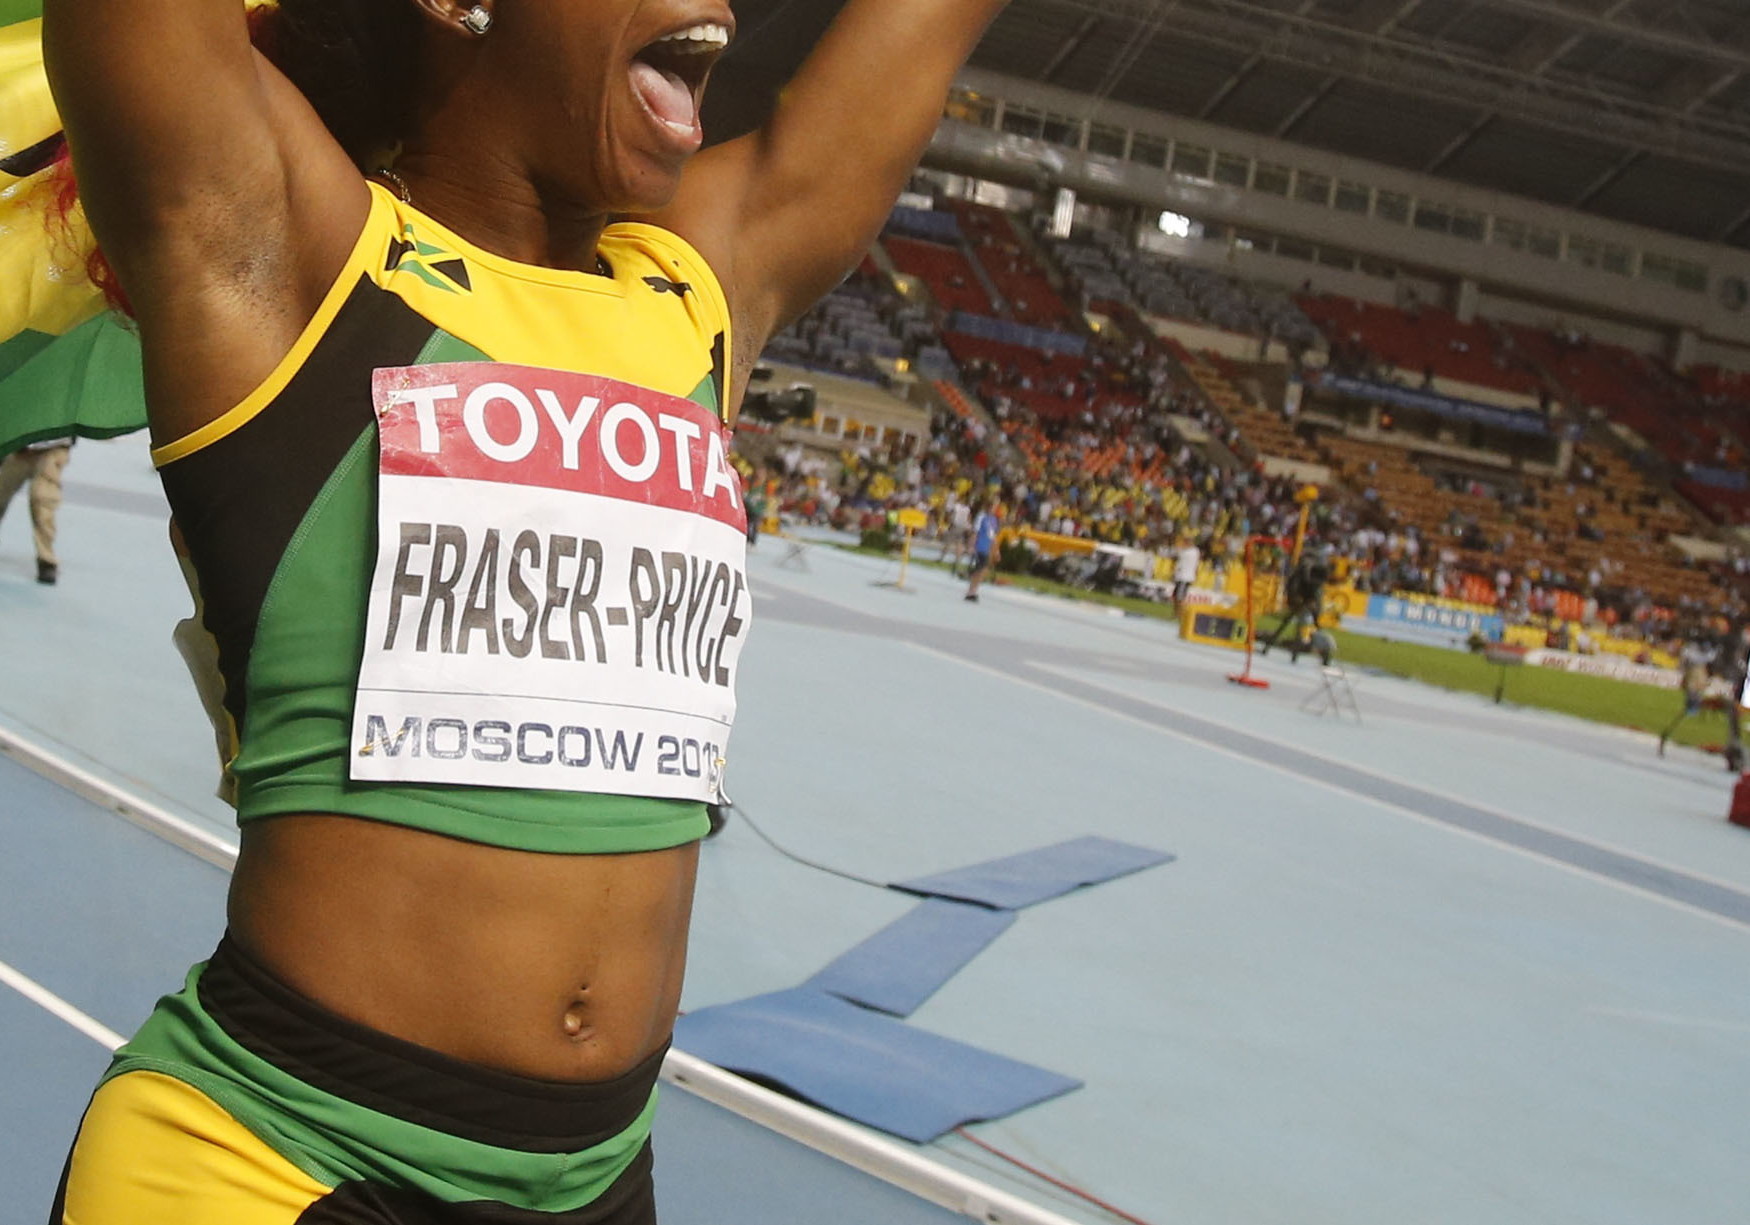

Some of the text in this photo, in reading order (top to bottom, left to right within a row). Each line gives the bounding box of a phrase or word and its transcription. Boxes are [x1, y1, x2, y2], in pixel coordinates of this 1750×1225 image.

[388, 381, 739, 510] TOYOTA
[383, 522, 746, 688] FRASER-PRYCE
[362, 714, 644, 772] MOSCOW
